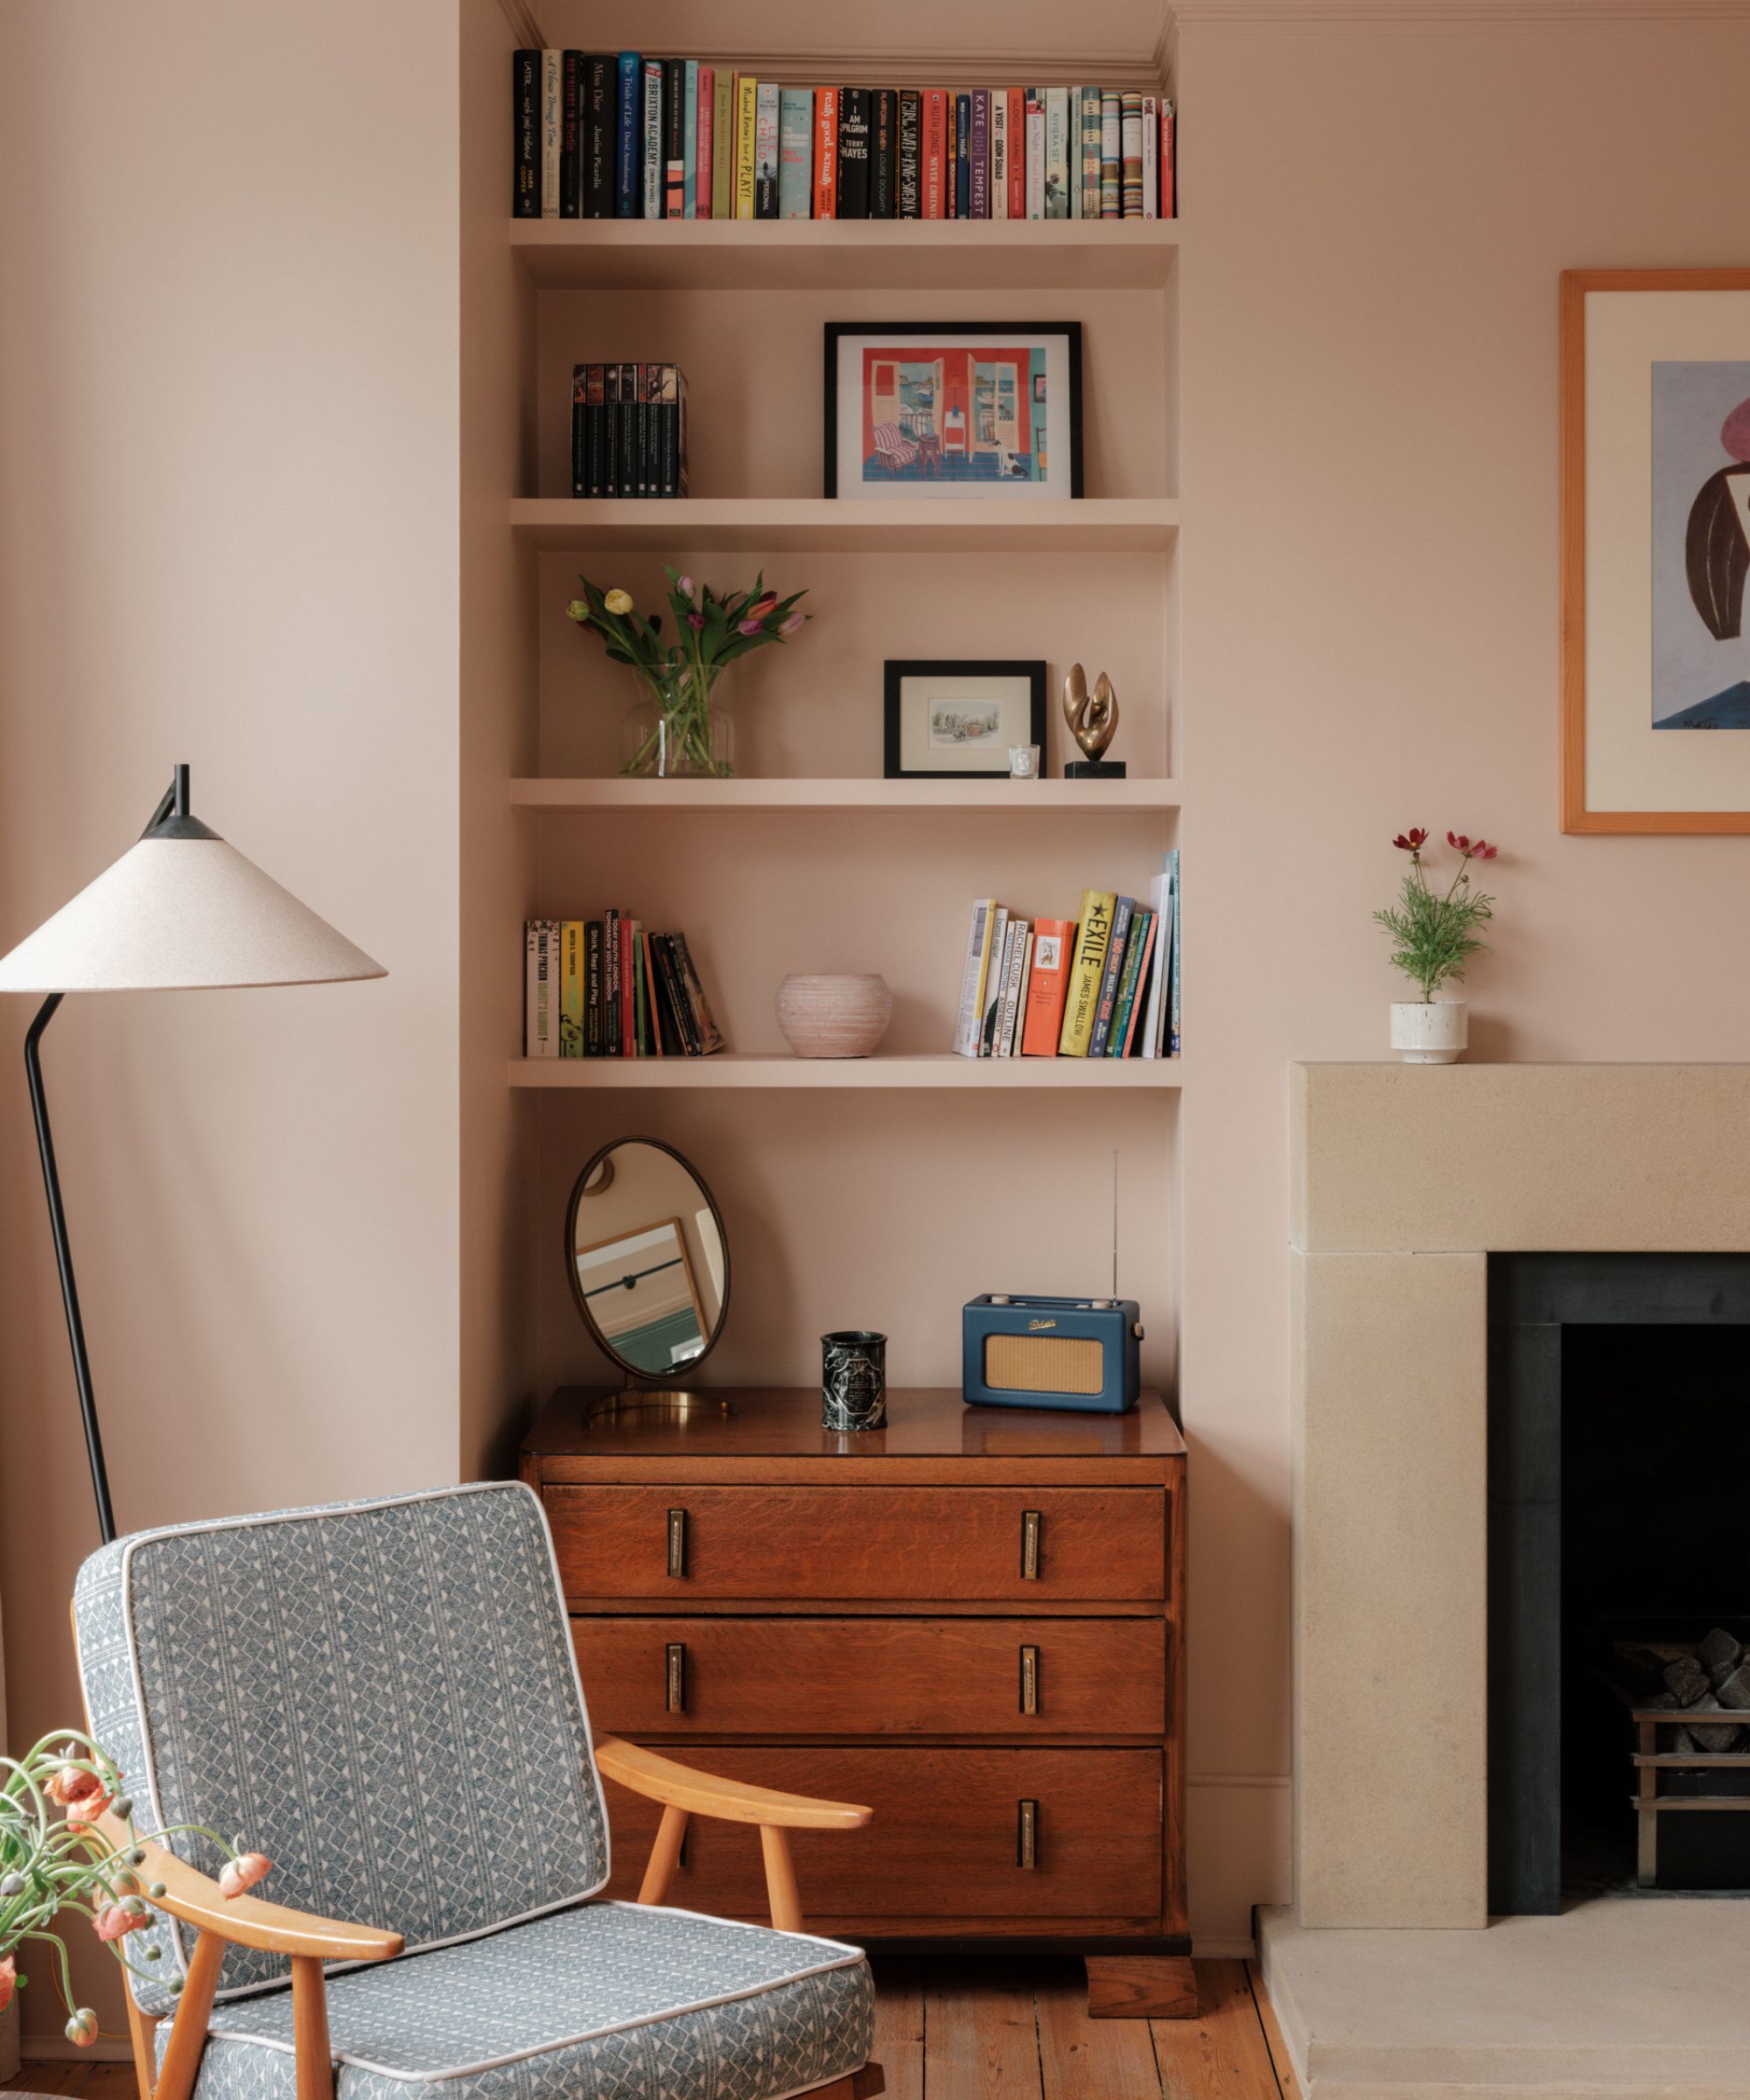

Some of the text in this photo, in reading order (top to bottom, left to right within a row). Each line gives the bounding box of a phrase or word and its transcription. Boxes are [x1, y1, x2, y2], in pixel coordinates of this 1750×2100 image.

[624, 58, 633, 75] The
[593, 63, 604, 112] Miss Dior
[624, 77, 633, 100] Trials
[648, 84, 658, 121] BRIXTON
[901, 102, 917, 120] GIRL
[975, 95, 984, 127] KATE
[1012, 99, 1021, 127] BLOOD
[842, 123, 868, 133] PILGRIM
[929, 106, 940, 155] RUTH JONES
[995, 112, 1004, 130] VISIT
[648, 123, 658, 165] ACADEMY
[759, 117, 768, 159] CHILD
[768, 126, 777, 150] LEE
[820, 92, 834, 187] really good, actually
[901, 127, 917, 152] SAVED
[995, 139, 1004, 157] GOON
[1031, 131, 1040, 151] Night
[1050, 113, 1060, 164] RIVIERA SET
[592, 125, 602, 188] Justine Picardie
[842, 148, 868, 158] HAYES
[622, 151, 631, 194] Attenborough
[901, 158, 917, 178] KING
[995, 158, 1004, 180] SQUAD
[739, 165, 752, 198] PLAY!
[928, 157, 938, 218] NEVER GREENER
[975, 160, 984, 214] TEMPEST
[901, 182, 917, 213] SWEDEN
[538, 933, 548, 954] THOMAS
[590, 928, 598, 950] Shirk,
[991, 917, 1005, 959] burnt sugar
[1081, 918, 1109, 969] EXILE
[1111, 937, 1124, 954] 100
[538, 956, 548, 981] PYNCHON
[1110, 953, 1118, 973] GREAT
[995, 932, 1013, 1034] NATASHA BROWN ASSEMBLY
[1003, 923, 1026, 1043] RACHEL CUSK OUTLINE
[1105, 974, 1116, 993] WALKS
[589, 989, 598, 1006] Play
[1073, 973, 1093, 1038] JAMES SWALLOW
[1099, 999, 1110, 1019] KIDS
